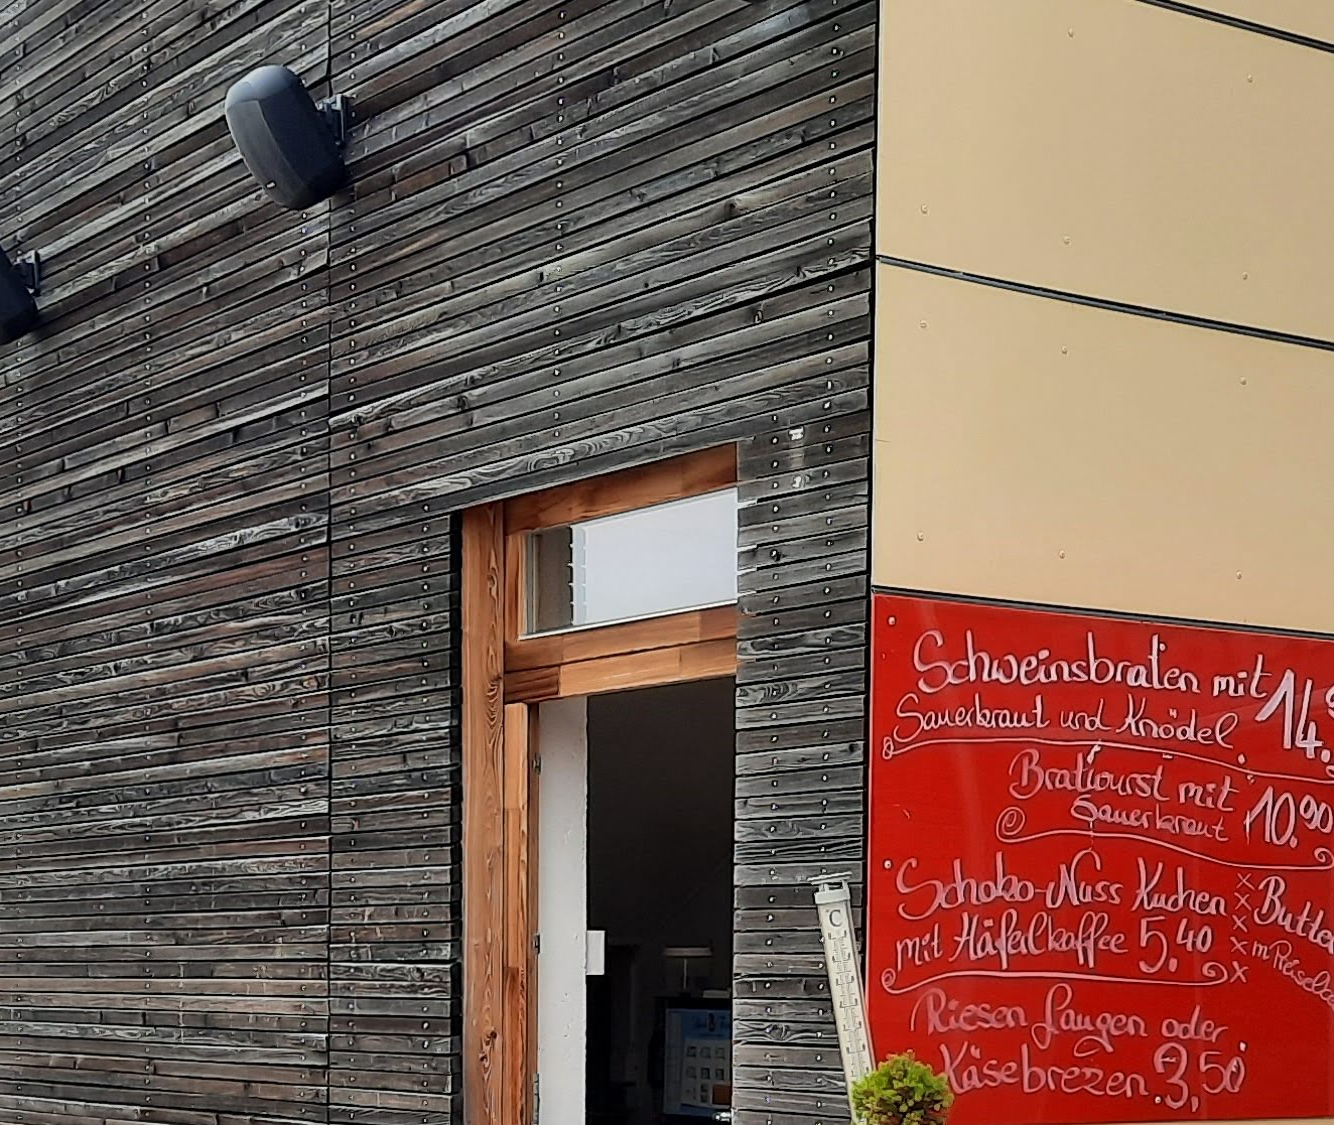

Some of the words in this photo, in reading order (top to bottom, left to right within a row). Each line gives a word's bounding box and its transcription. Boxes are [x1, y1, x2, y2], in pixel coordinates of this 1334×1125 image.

[913, 629, 1201, 693] Schweinsbraten
[1213, 654, 1272, 698] mit
[893, 692, 1050, 742] Sauerkraut
[1060, 698, 1111, 731] und
[1116, 693, 1238, 748] Knödel
[1009, 748, 1169, 800] Bratwurst
[1179, 775, 1238, 812] mit
[1070, 794, 1229, 841] Sauerkraut
[896, 848, 1123, 920] Schoko-Nuss
[1131, 857, 1227, 916] Kuchen
[896, 923, 943, 971] mit
[911, 988, 1028, 1035] Riesen
[1032, 983, 1148, 1057] Laugen
[1161, 1004, 1228, 1042] oder
[940, 1041, 1149, 1098] Käsebrezen
[1154, 1041, 1246, 1112] 3,50
